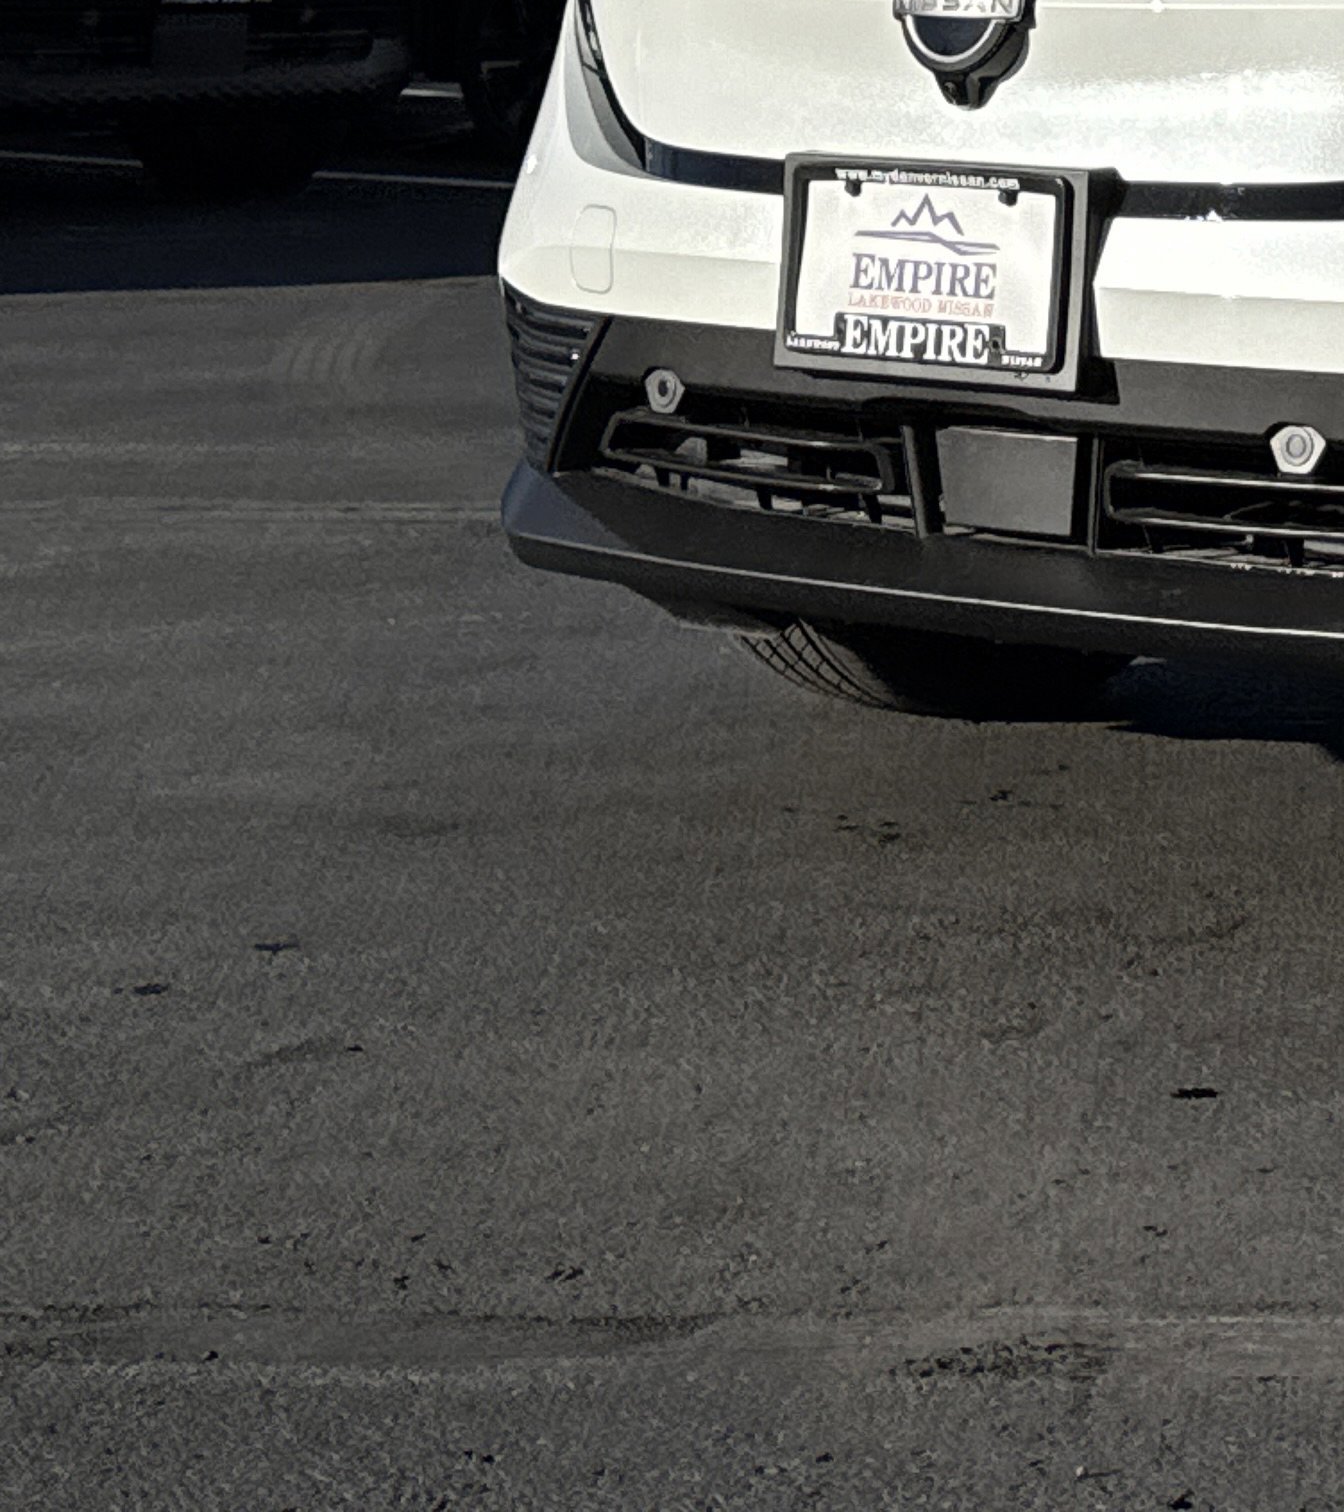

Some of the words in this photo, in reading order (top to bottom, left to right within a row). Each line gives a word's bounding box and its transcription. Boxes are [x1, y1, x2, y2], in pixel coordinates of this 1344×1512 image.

[849, 253, 997, 300] EMPIRE
[848, 292, 932, 313] LAKEWOOD
[937, 299, 995, 319] NISSAN
[840, 314, 990, 366] EMPIRE
